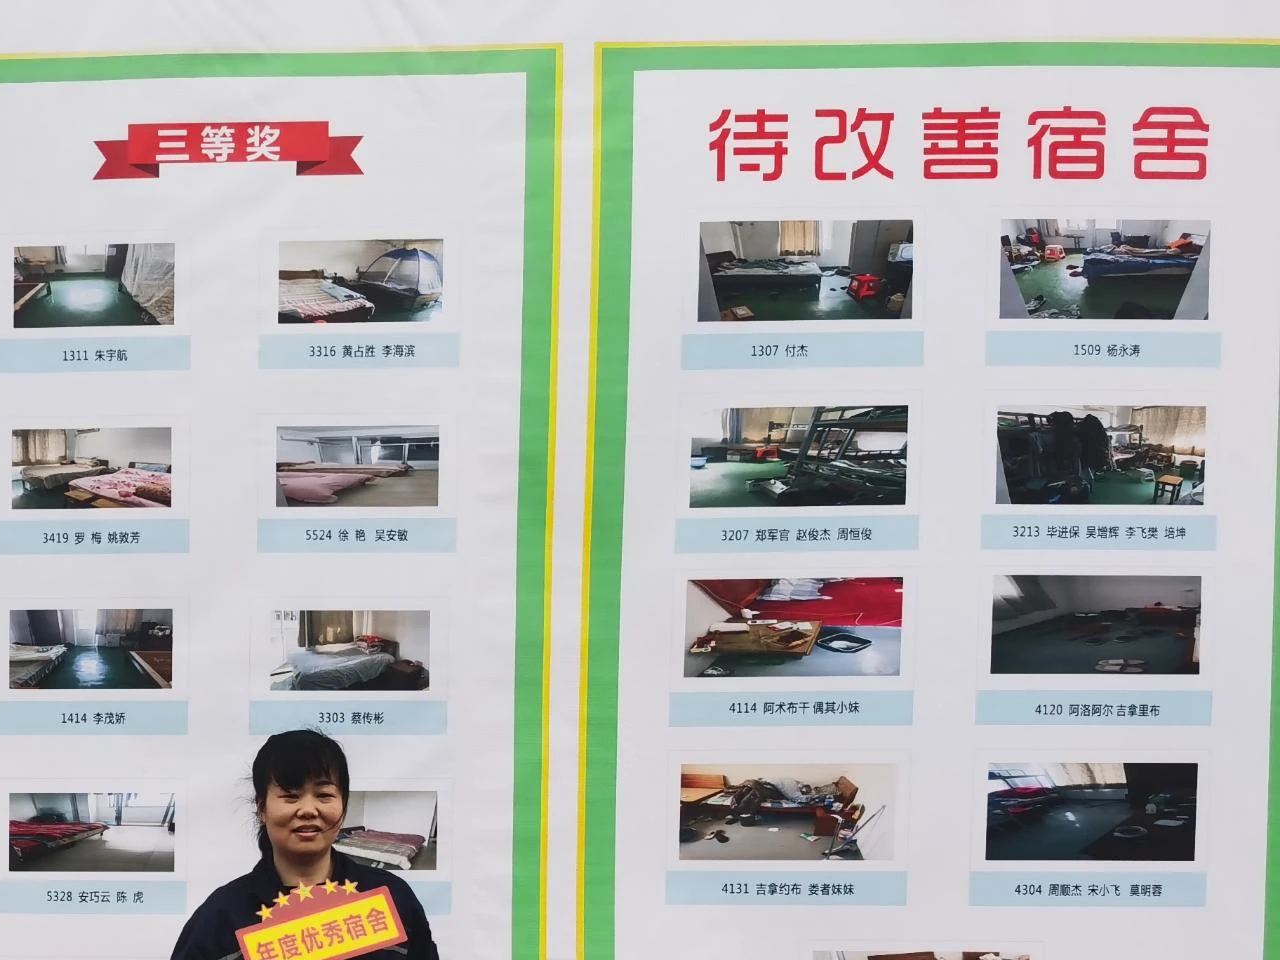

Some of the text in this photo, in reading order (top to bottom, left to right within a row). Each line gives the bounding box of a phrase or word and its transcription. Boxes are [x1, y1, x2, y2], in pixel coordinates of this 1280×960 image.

[155, 125, 280, 162] 三等奖
[709, 106, 1211, 182] 待改善宿舍
[62, 348, 129, 362] 1311 朱宇航
[308, 343, 416, 359] 3316 黄占胜 李海滨
[751, 343, 809, 358] 1307 付杰
[1073, 343, 1141, 358] 1509 杨永涛
[42, 532, 69, 544] 3419
[305, 529, 333, 541] 5524
[374, 528, 409, 543] 吴安敏
[720, 527, 873, 543] 3207 郑军官 赵俊杰 周恒俊
[1012, 525, 1041, 538] 3213
[1045, 525, 1081, 540] 毕进保
[1085, 525, 1120, 540] 吴增辉
[728, 701, 758, 714] 4114
[1034, 703, 1161, 718] 4120 阿洛阿尔 吉拿里布
[60, 712, 88, 724] 1414
[318, 711, 345, 724] 3303
[721, 882, 750, 895] 4131
[755, 882, 803, 896] 吉拿约布
[1014, 883, 1043, 896] 4304
[1047, 883, 1083, 897] 周顺杰
[46, 890, 73, 902] 5328
[77, 890, 111, 904] 安巧云
[256, 907, 389, 960] 年度优秀宿舍
